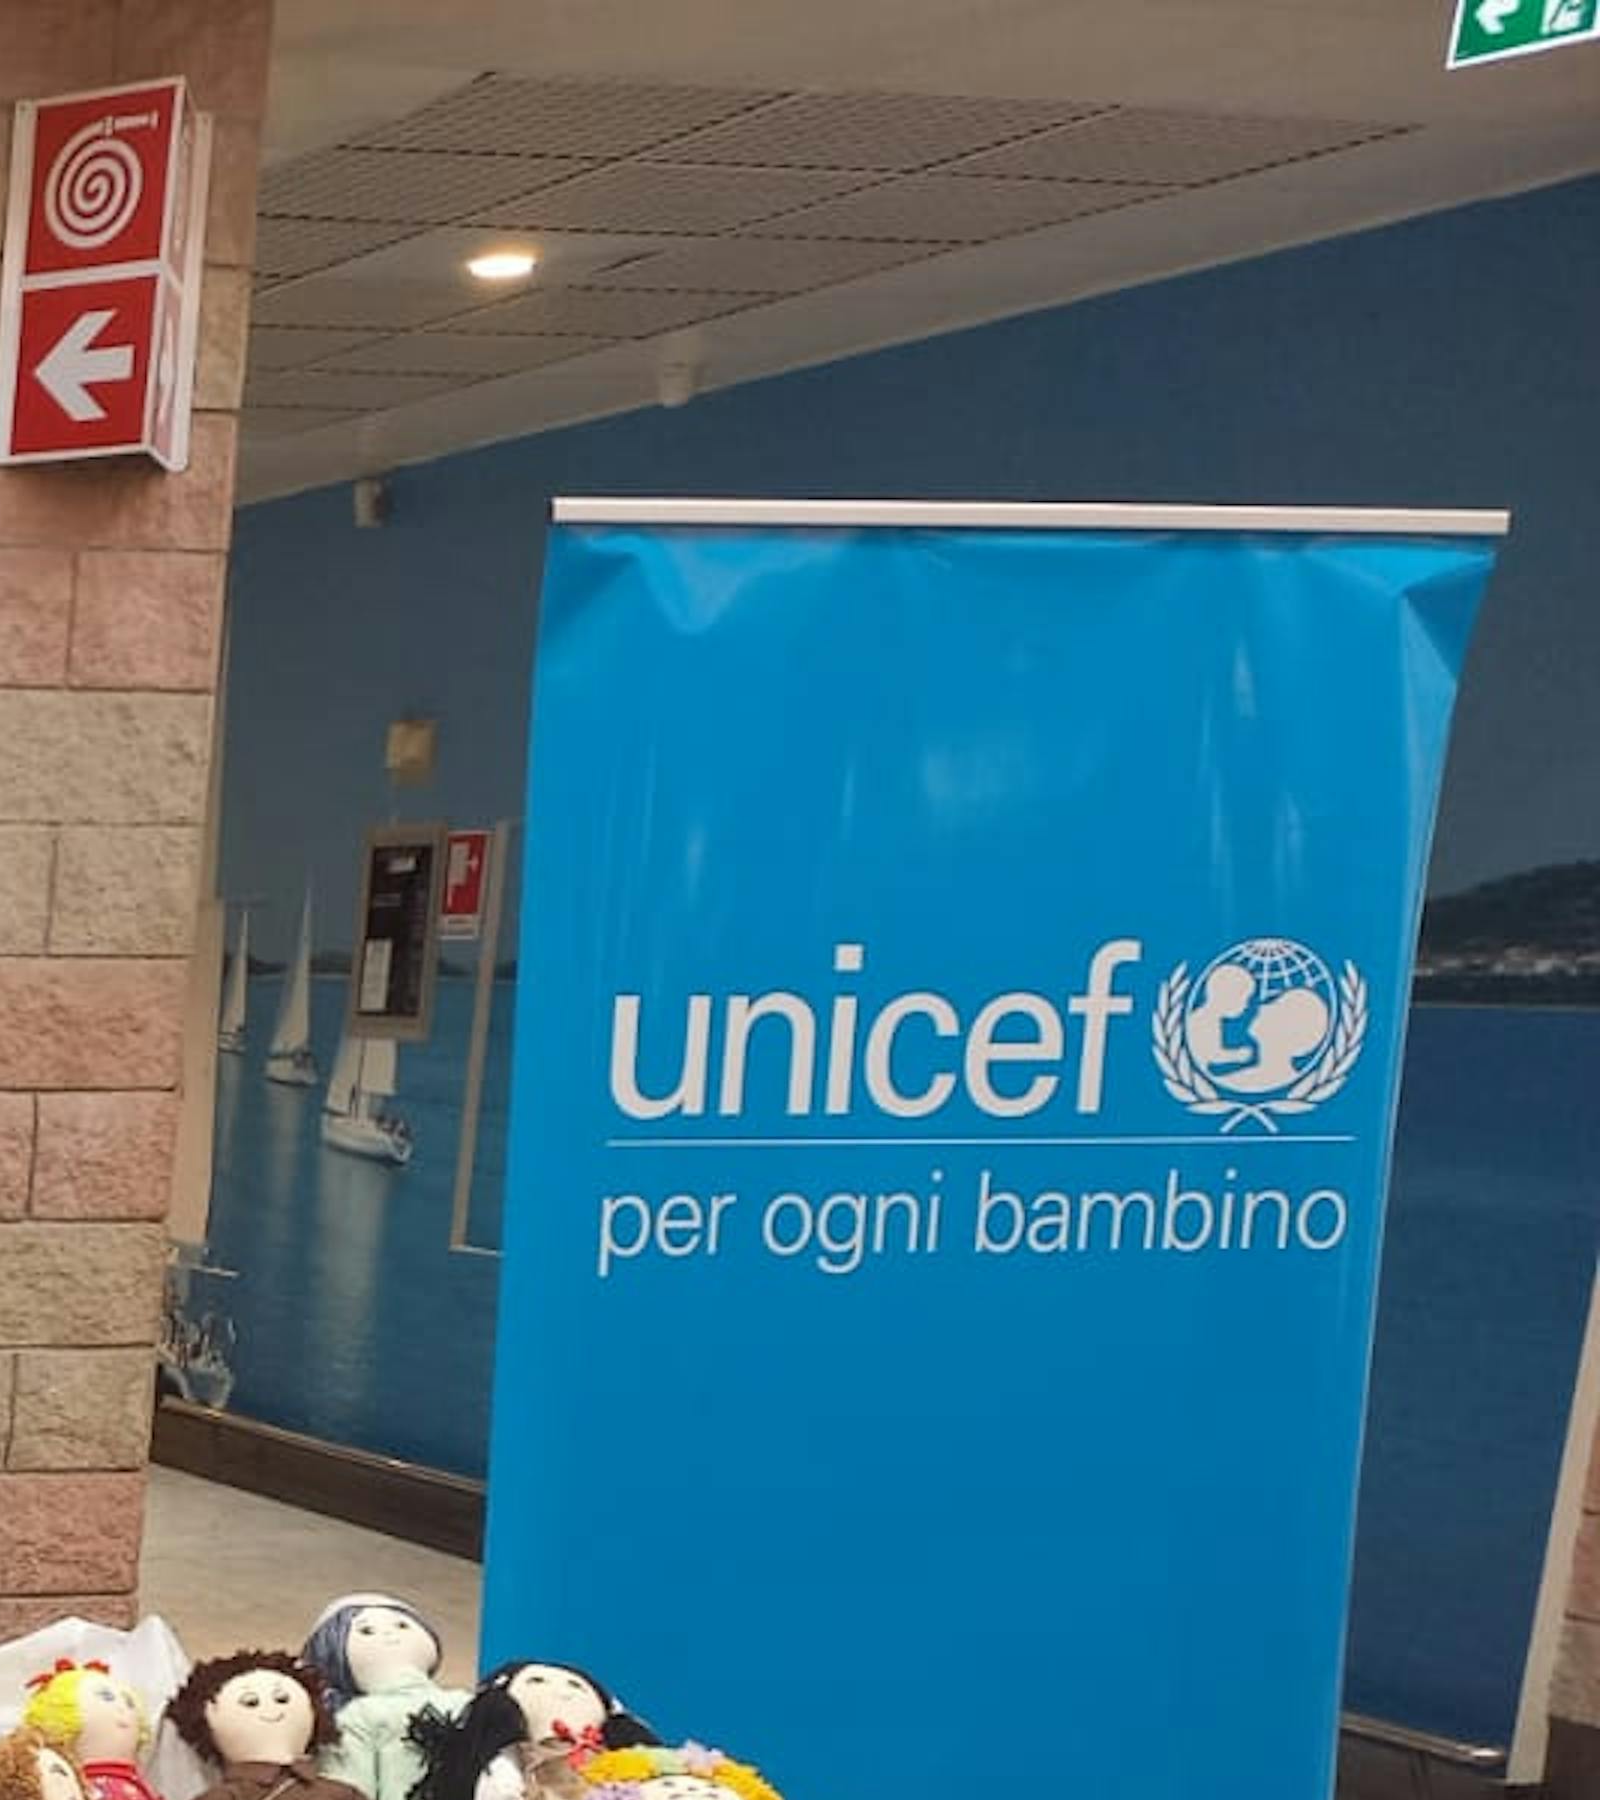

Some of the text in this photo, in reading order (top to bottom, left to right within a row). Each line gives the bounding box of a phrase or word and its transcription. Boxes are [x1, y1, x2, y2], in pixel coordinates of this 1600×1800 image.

[608, 939, 1141, 1118] unicef
[597, 1169, 1349, 1277] per ogni bambino
